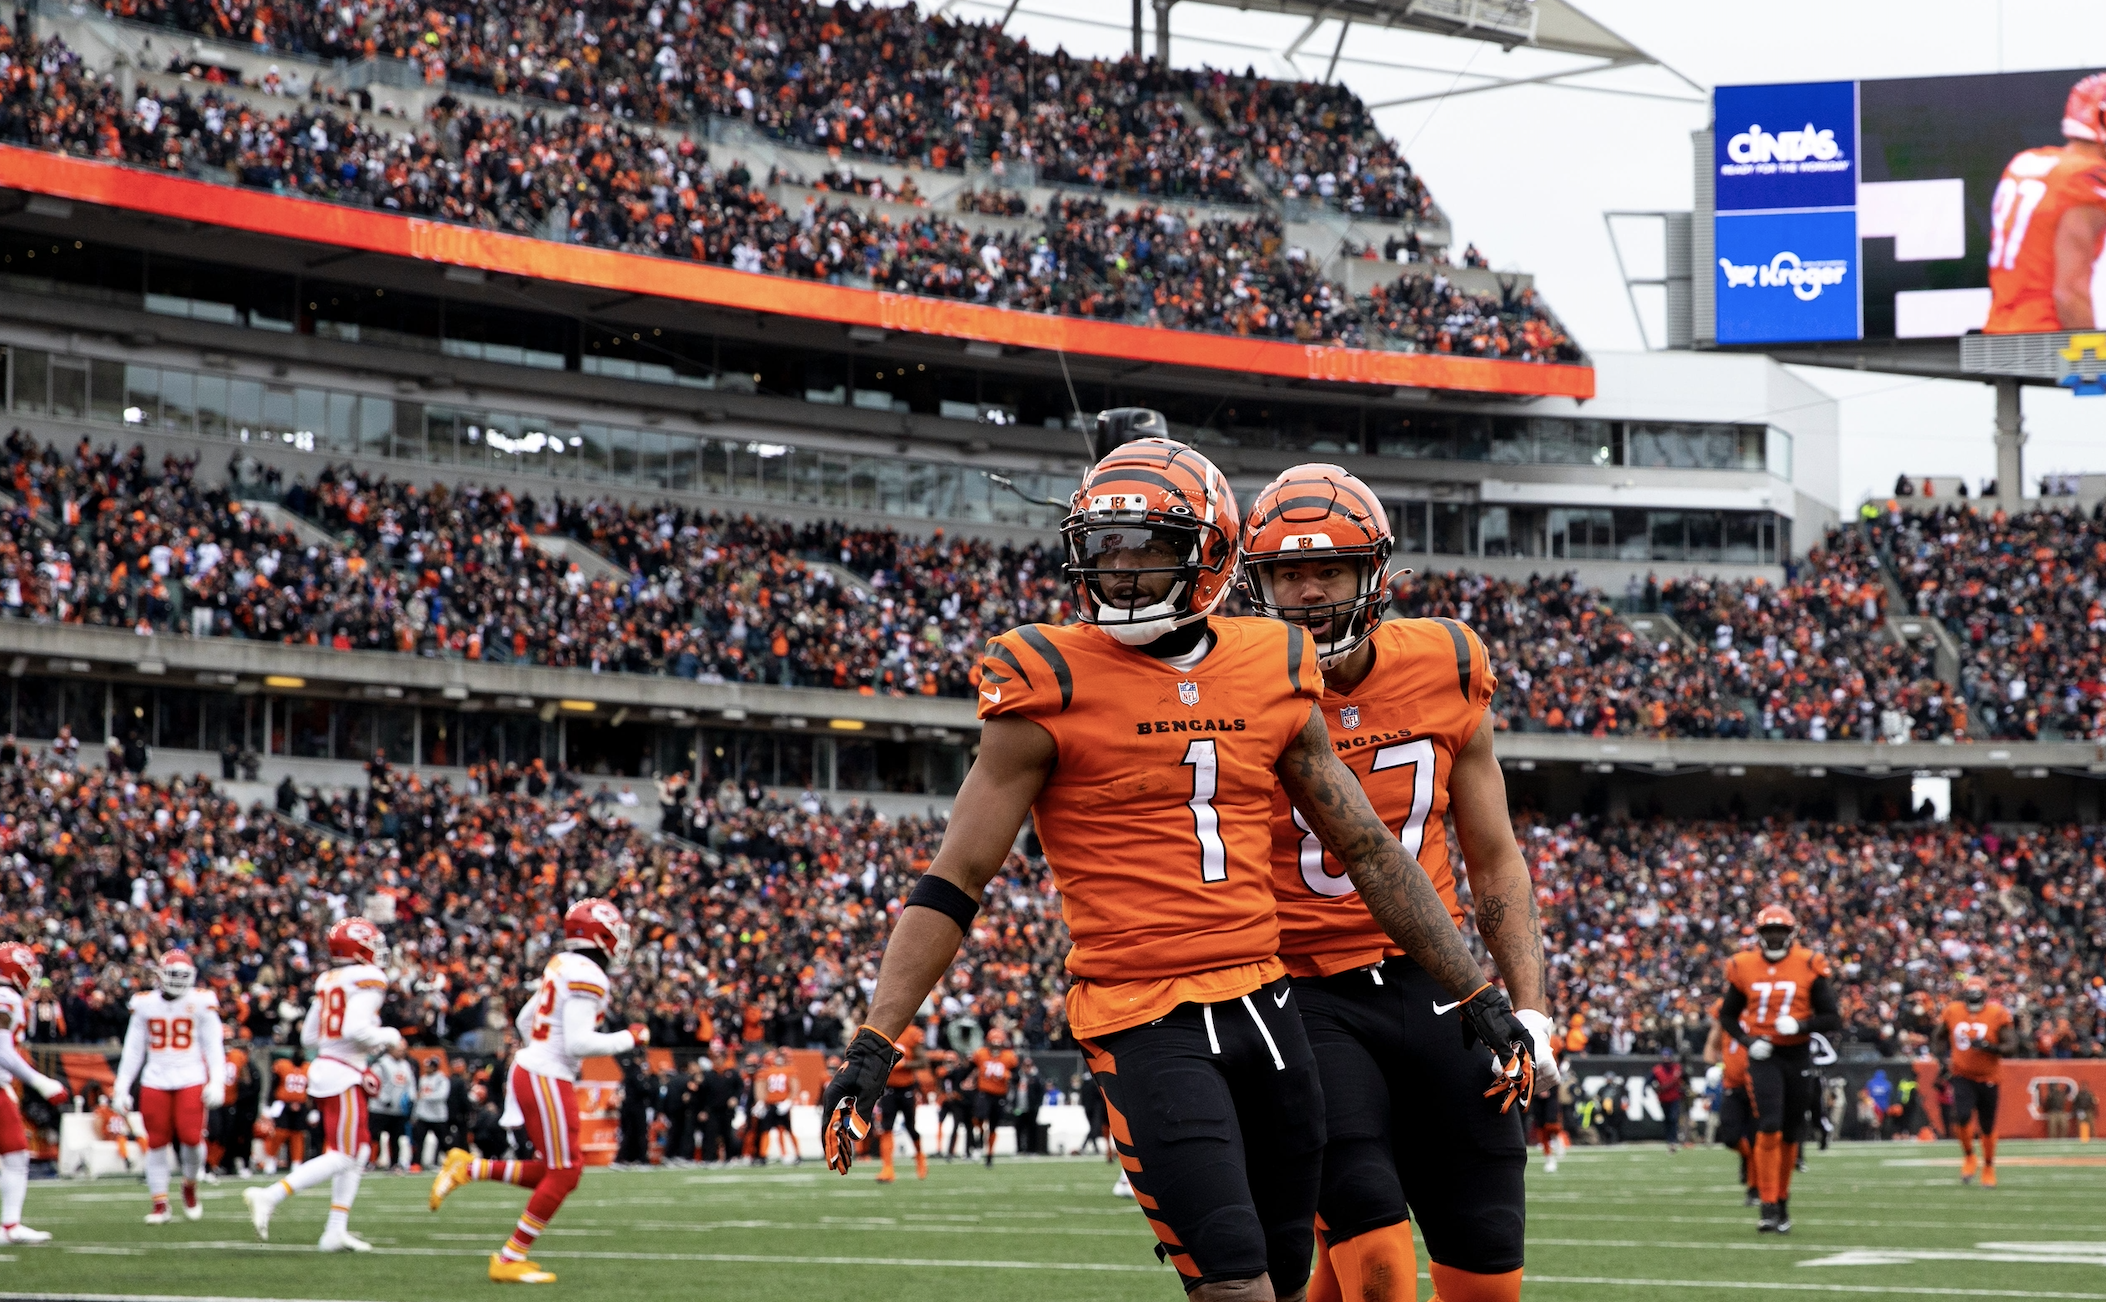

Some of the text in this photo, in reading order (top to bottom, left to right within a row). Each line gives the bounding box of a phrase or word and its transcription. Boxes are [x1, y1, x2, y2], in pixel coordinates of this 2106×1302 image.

[1759, 251, 1847, 301] Kroger
[1182, 691, 1197, 702] NFL
[1136, 719, 1246, 735] BENGALS
[1344, 716, 1358, 726] NFL
[1331, 728, 1412, 753] NGALS
[1179, 737, 1229, 884] 1
[1751, 981, 1797, 1023] 77
[147, 1017, 194, 1051] 98
